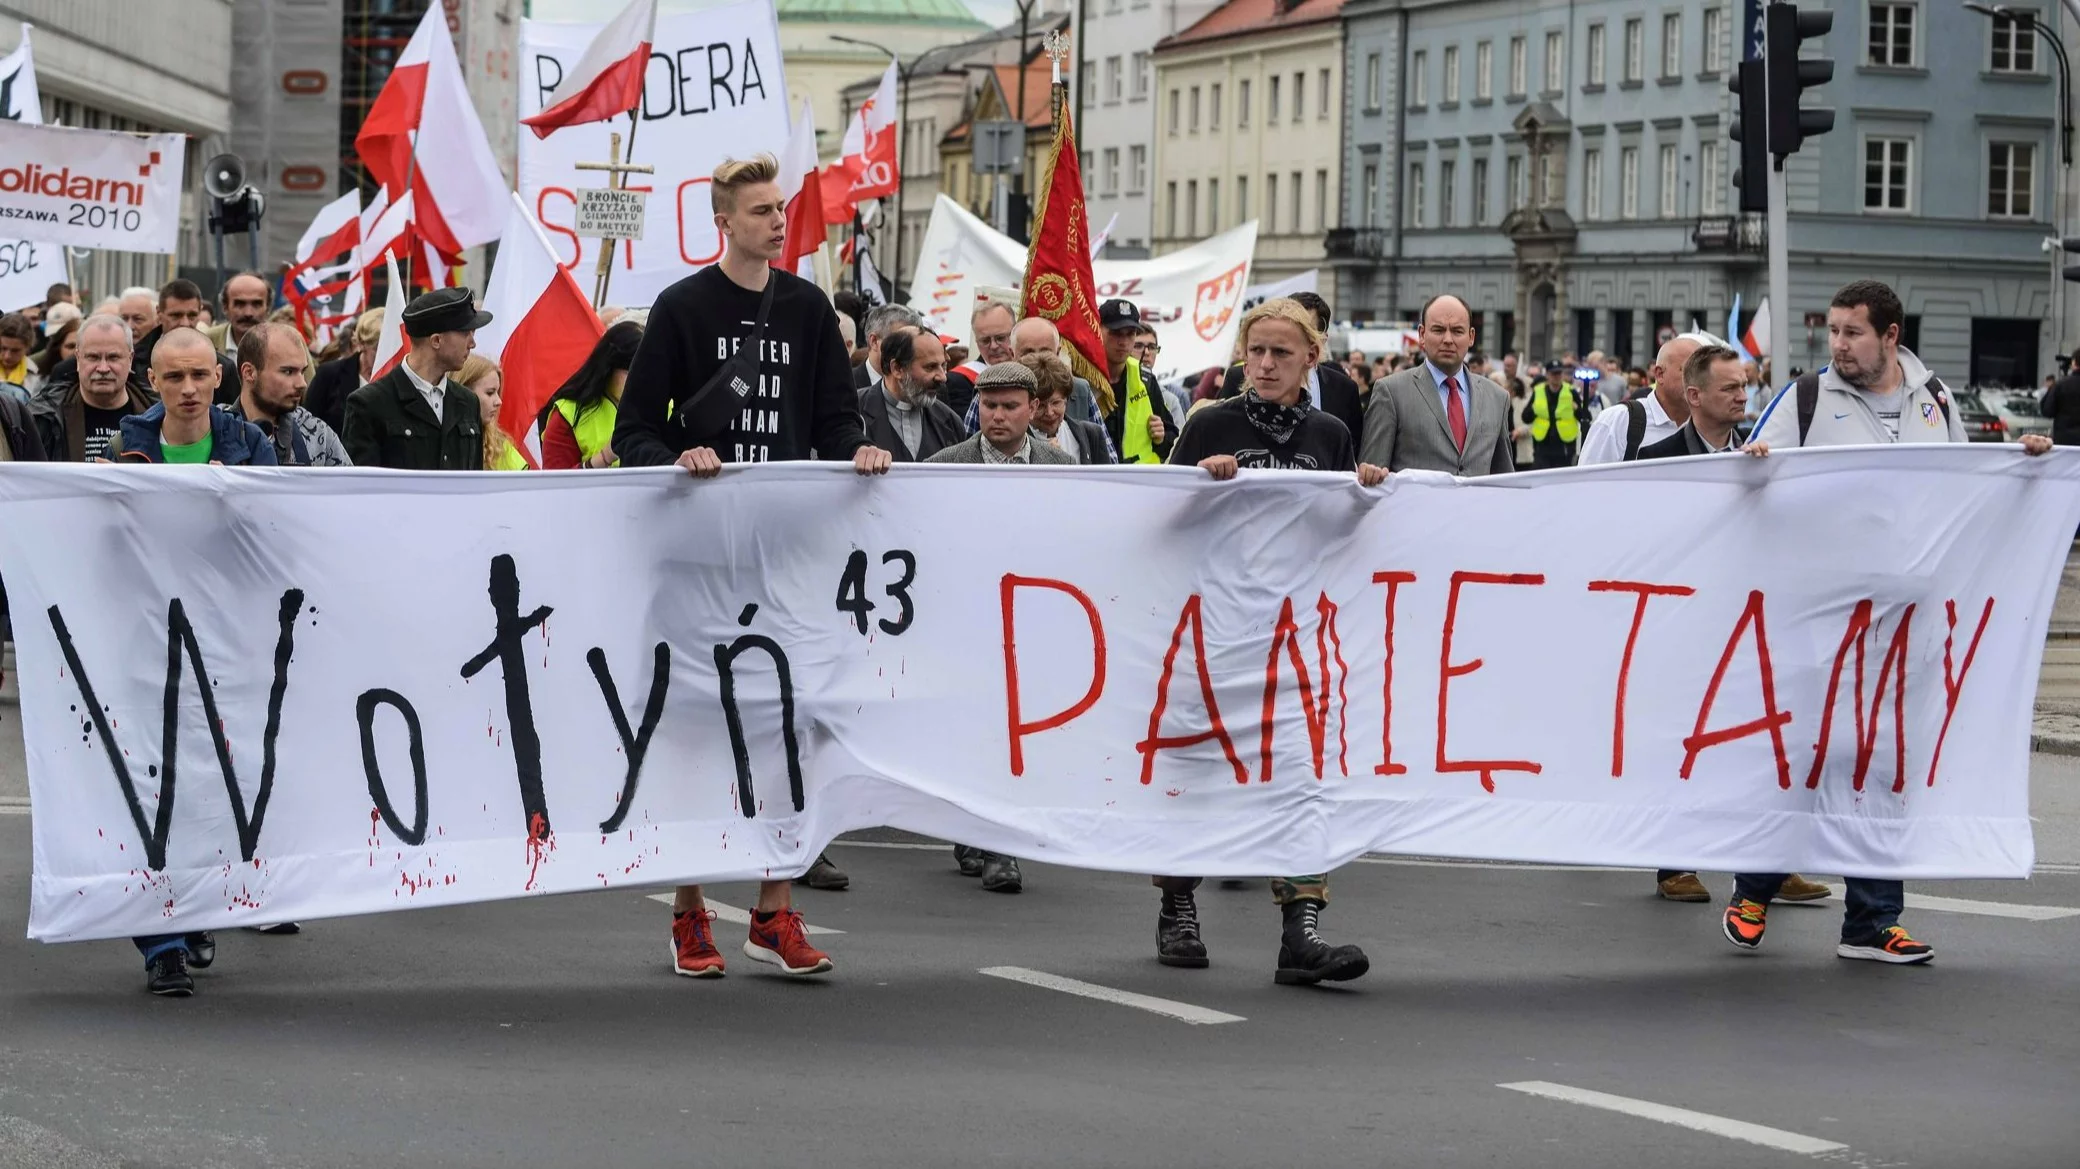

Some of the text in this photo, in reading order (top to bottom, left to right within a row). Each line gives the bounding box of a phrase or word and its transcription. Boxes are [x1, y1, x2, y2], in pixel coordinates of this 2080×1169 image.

[536, 38, 766, 122] BDERA
[0, 163, 144, 206] olidarni
[0, 203, 142, 232] RSZAWA 2010
[630, 205, 643, 213] OD
[537, 177, 726, 270] STO
[580, 221, 593, 229] DO
[1041, 283, 1060, 308] 1830
[717, 337, 790, 365] BETER
[758, 374, 781, 399] AD
[49, 549, 1995, 871] Wołyń 43 PAMIĘTAMY
